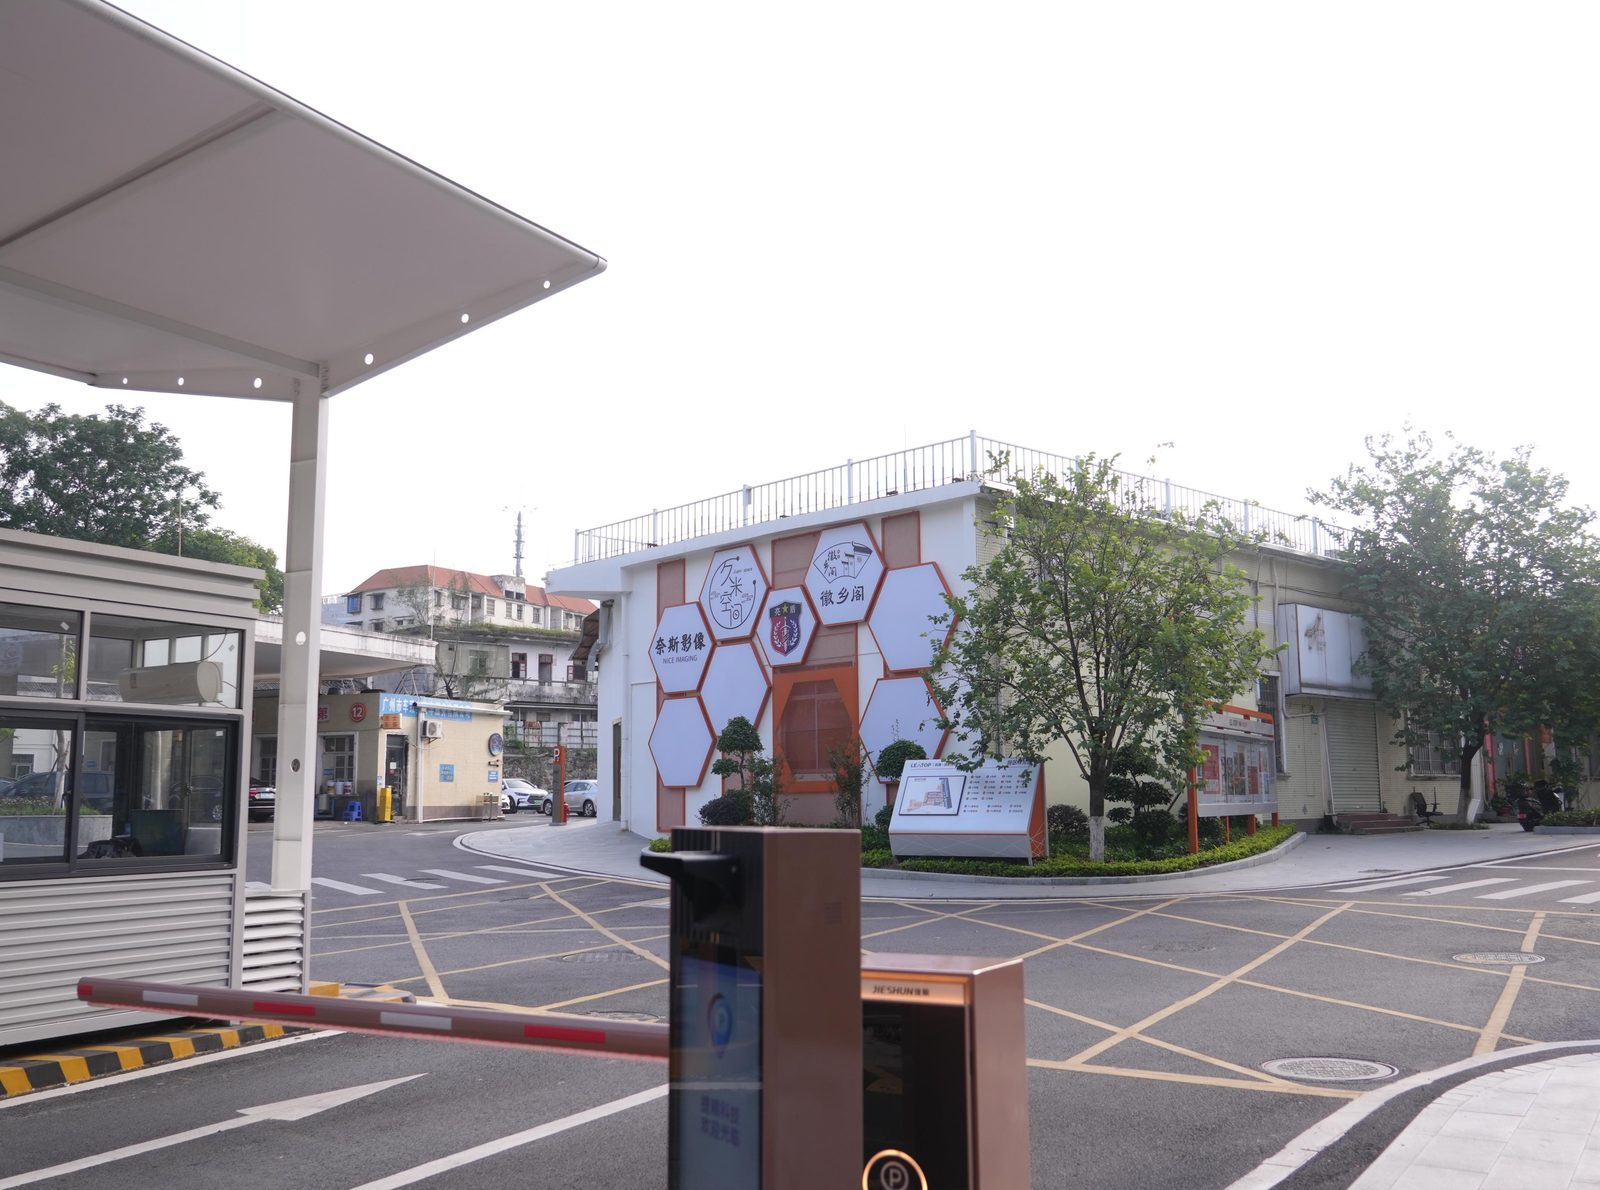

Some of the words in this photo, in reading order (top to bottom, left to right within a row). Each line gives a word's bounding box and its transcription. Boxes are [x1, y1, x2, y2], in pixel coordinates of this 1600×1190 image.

[820, 585, 865, 607] 徽乡阁
[655, 632, 706, 655] 奈斯影像
[663, 656, 675, 664] NICE
[676, 655, 698, 663] IMAGING
[352, 706, 363, 718] 12
[872, 985, 913, 995] JIESHUN
